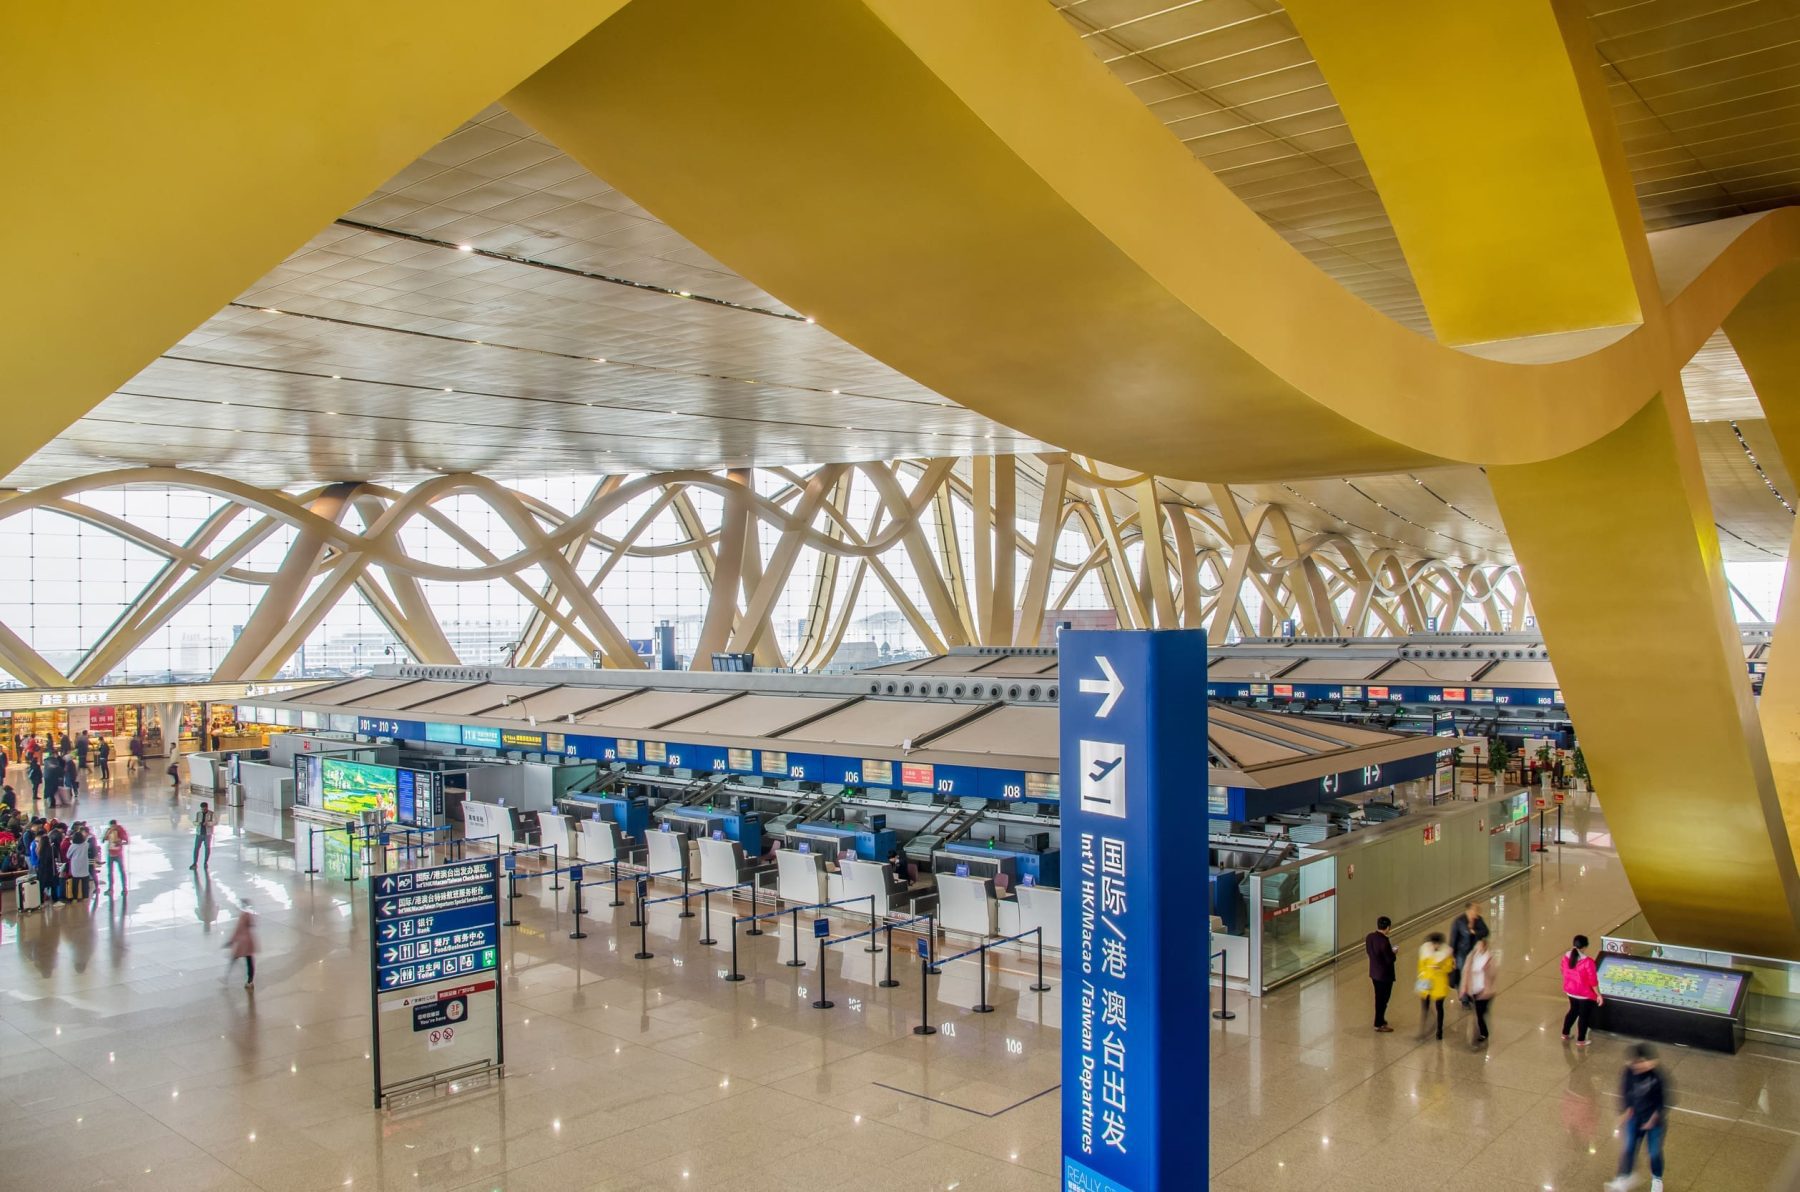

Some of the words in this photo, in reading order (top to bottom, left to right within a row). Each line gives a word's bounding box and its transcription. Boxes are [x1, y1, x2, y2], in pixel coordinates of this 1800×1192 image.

[1283, 621, 1289, 633] F
[1427, 618, 1435, 629] E
[1526, 617, 1534, 626] D
[637, 640, 645, 654] 2
[1237, 689, 1249, 697] H02
[1294, 690, 1305, 698] H03
[1389, 693, 1402, 701] H05
[1428, 694, 1441, 702] H06
[360, 719, 370, 731] J01
[378, 720, 389, 733] J10
[567, 745, 577, 755] J01
[604, 748, 616, 759] J02
[668, 755, 681, 766] J03
[713, 758, 726, 770] J04
[790, 766, 804, 778] J05
[844, 771, 859, 784] J06
[1333, 773, 1339, 792] J
[1363, 765, 1371, 785] H
[937, 779, 954, 793] J07
[1003, 785, 1020, 799] J08
[417, 917, 434, 927] 银行
[1081, 880, 1095, 974] HK/Macao
[434, 937, 450, 947] 餐厅
[453, 930, 485, 944] 商务中心
[417, 961, 441, 973] 卫生间
[417, 971, 436, 980] Toilet
[1079, 1055, 1095, 1155] Departures
[1067, 1165, 1101, 1192] REALLY
